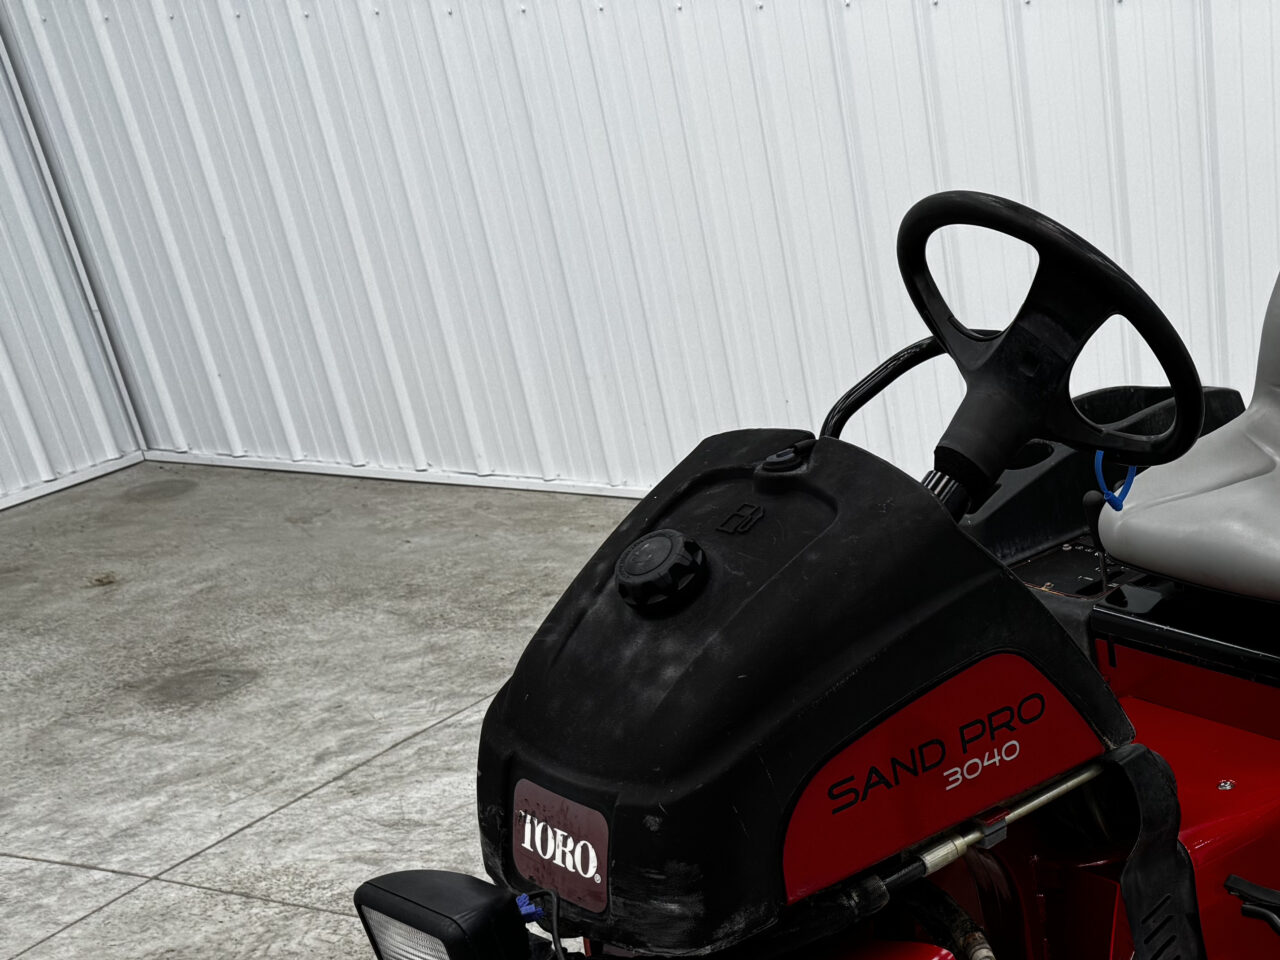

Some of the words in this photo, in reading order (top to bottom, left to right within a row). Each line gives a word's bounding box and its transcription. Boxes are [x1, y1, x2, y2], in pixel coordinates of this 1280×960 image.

[828, 738, 946, 815] SAND
[960, 693, 1046, 754] PRO
[943, 739, 1020, 791] 3040
